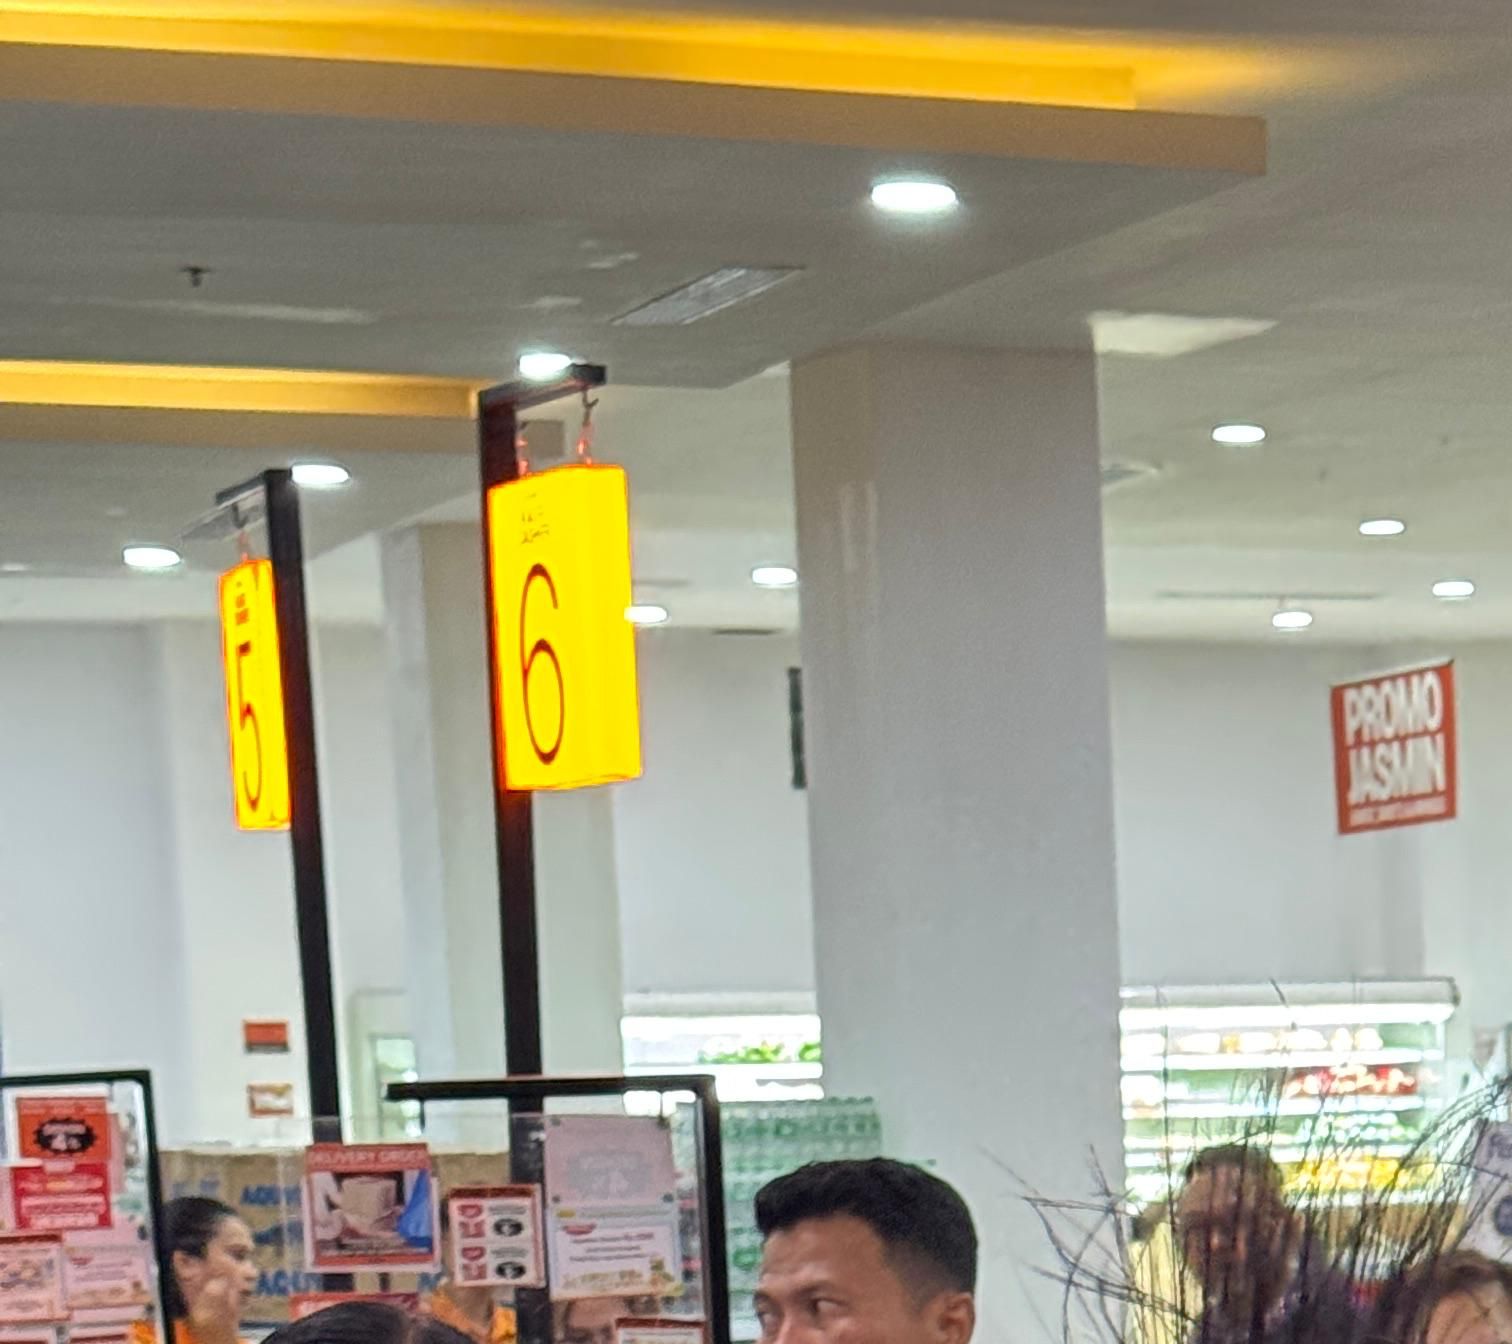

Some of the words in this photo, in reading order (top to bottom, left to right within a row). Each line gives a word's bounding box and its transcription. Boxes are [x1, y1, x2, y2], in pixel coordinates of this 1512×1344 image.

[236, 640, 263, 812] 5
[519, 562, 565, 766] 6
[1343, 670, 1443, 747] PROMO
